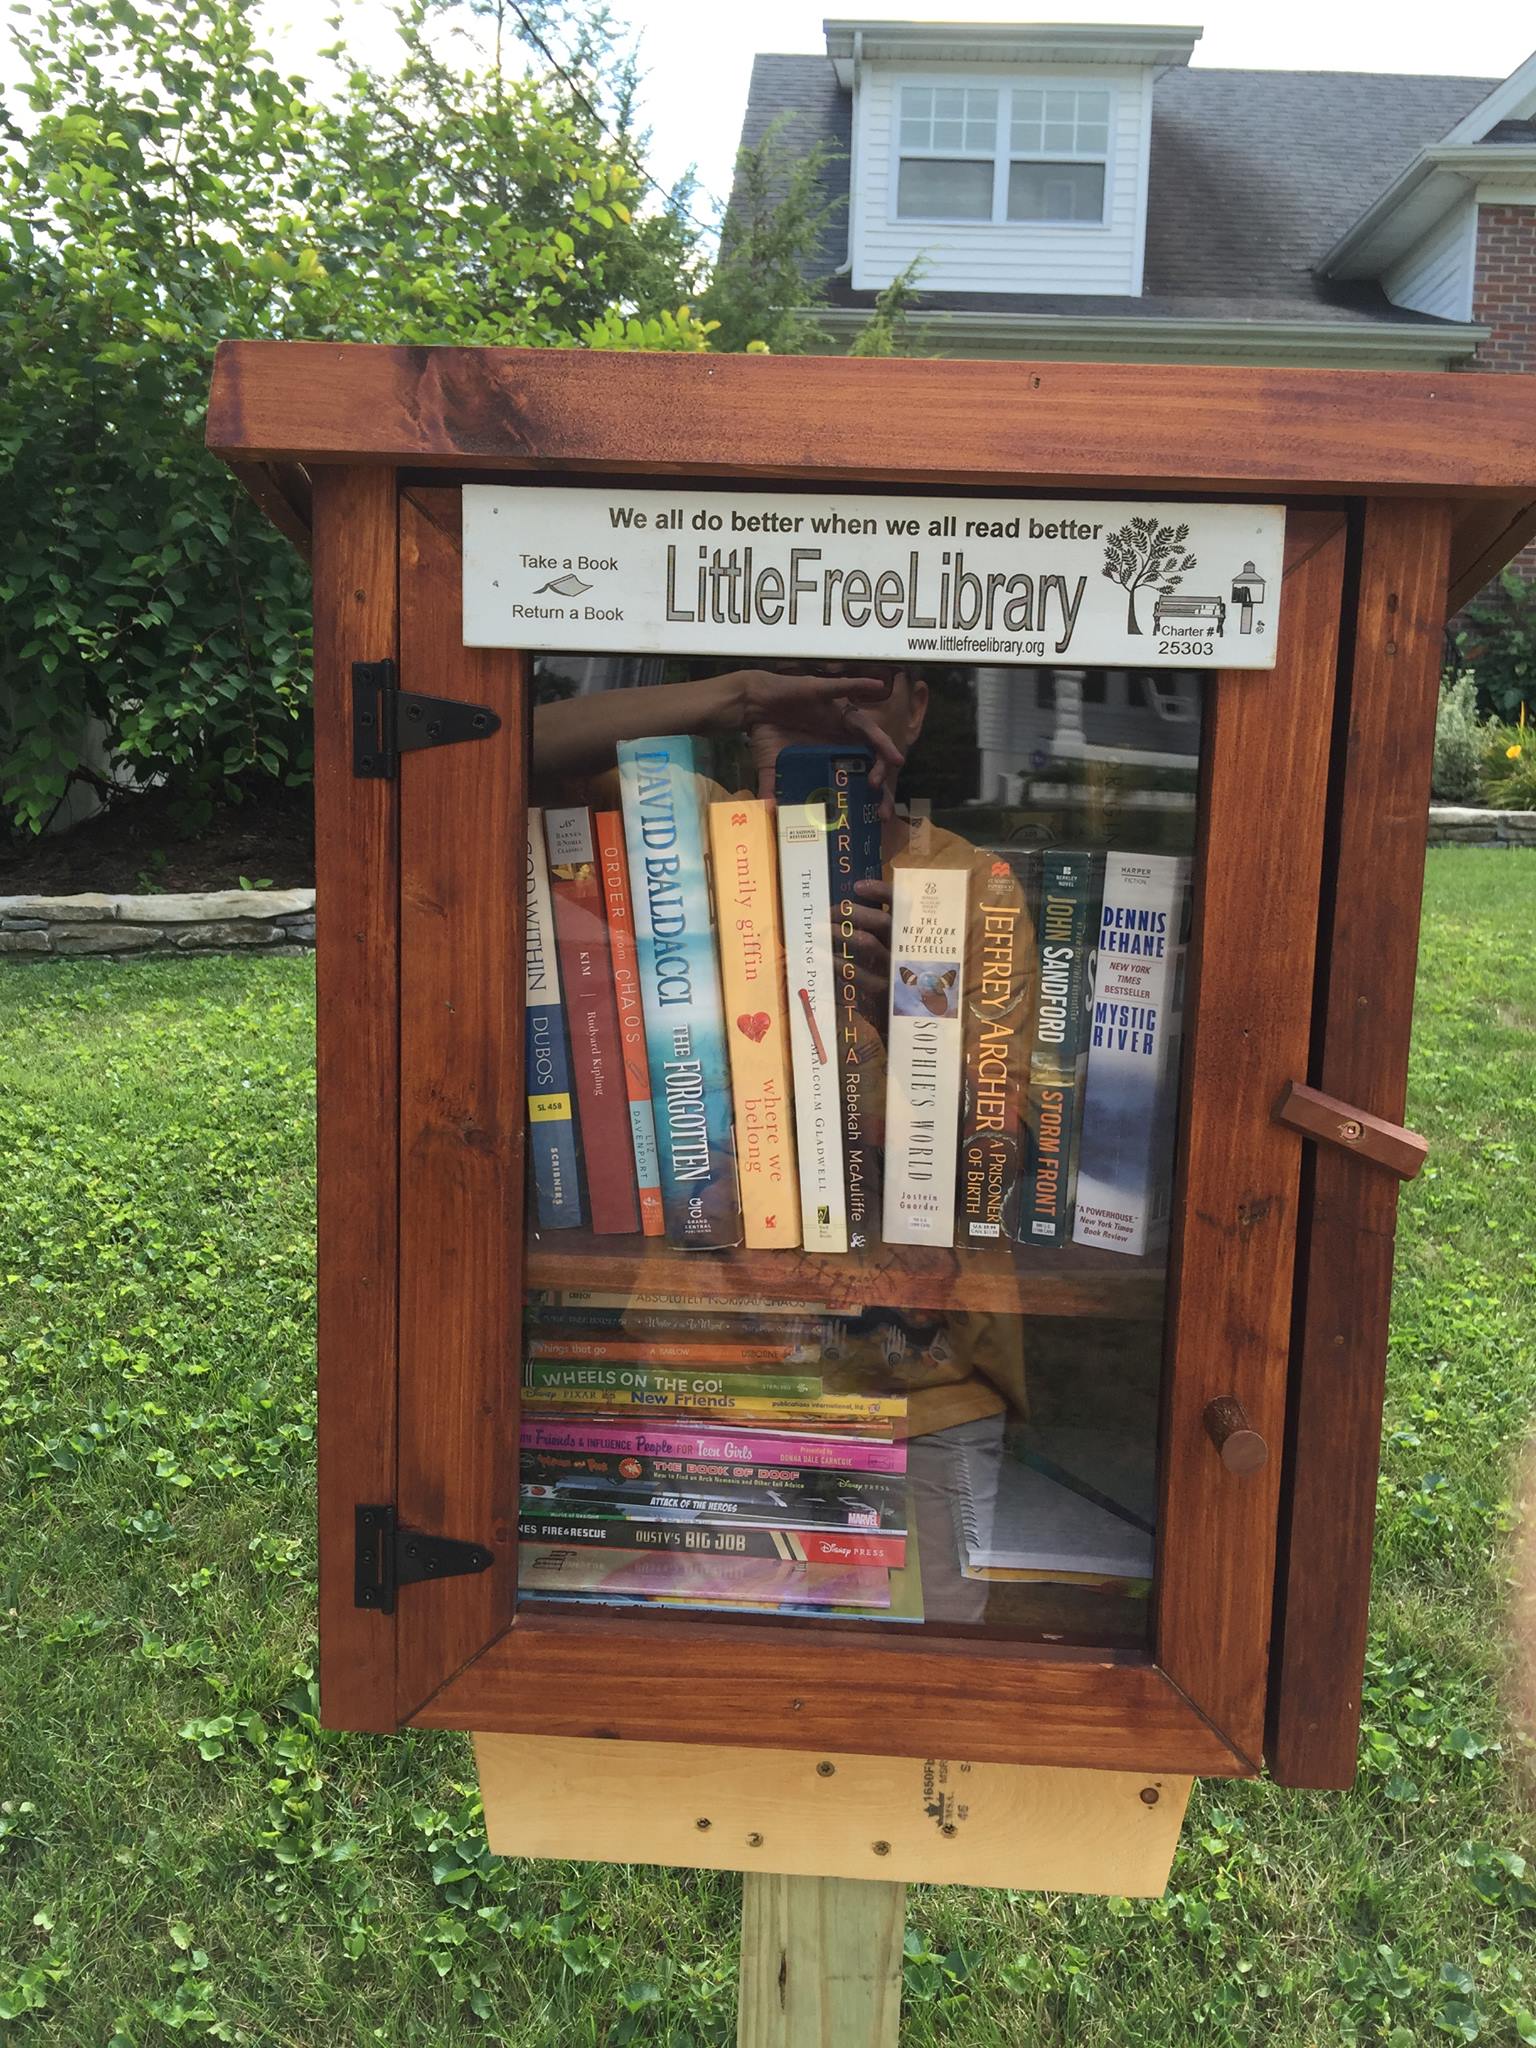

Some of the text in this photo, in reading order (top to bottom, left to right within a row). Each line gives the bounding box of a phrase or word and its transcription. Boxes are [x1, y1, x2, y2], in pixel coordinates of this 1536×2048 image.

[609, 507, 1103, 541] We all do better when we all read better
[519, 554, 619, 571] Take a Book
[666, 544, 1087, 653] LittleFreeLibrary
[512, 604, 624, 621] Return a Book
[1161, 624, 1216, 638] Charter #
[907, 636, 1045, 657] www.littlefreelibrary.org
[1158, 641, 1214, 656] 25303
[835, 769, 851, 873] GEARS
[635, 751, 693, 1008] DAVID BALDACCI
[1121, 866, 1151, 875] HARPER
[1124, 877, 1147, 885] FICTION
[801, 870, 812, 898] THE
[735, 844, 762, 981] emily giffin
[921, 917, 938, 925] THE
[1103, 906, 1166, 933] DENNIS
[803, 905, 814, 965] TIPPING
[903, 926, 957, 936] NEW YORK
[914, 936, 944, 945] TIMES
[604, 847, 640, 1043] ORDER from CHAOS
[898, 945, 957, 954] BESTSELLER
[979, 902, 1021, 1010] JEFFREY
[1100, 930, 1165, 958] LEHANE
[579, 952, 591, 976] KIM
[1038, 895, 1077, 1044] JOHN SANDFORD
[1109, 962, 1151, 975] NEW YORK
[839, 899, 859, 1064] GOLGOTHA
[1117, 974, 1141, 985] TIMES
[1104, 985, 1151, 999] BESTSELLER
[1095, 1002, 1157, 1031] MYSTIC
[532, 1017, 553, 1085] DUBOS
[1093, 1026, 1153, 1055] RIVER
[587, 1011, 604, 1096] Rudyard Kipling
[976, 1019, 1015, 1131] ARCHER
[537, 1102, 562, 1112] SL 458
[663, 1023, 711, 1181] THE FORGOTTEN
[908, 1021, 938, 1181] SOPHIE'S WORLD
[763, 1078, 782, 1182] where we
[1038, 1090, 1064, 1153] STORM
[633, 1110, 647, 1179] DAVENPORT
[645, 1134, 655, 1153] LIZ
[744, 1099, 764, 1173] belong
[846, 1073, 866, 1222] Rebekah McAuliffe
[815, 1118, 827, 1192] GLADWELL
[968, 1148, 983, 1167] OF
[551, 1147, 563, 1205] SCRIBNERS
[987, 1139, 1006, 1222] A PRISONER
[1035, 1157, 1059, 1216] FRONT
[901, 1192, 938, 1201] Jostein
[967, 1171, 984, 1214] BIRTH
[1080, 1216, 1134, 1233] New York Times
[1083, 1226, 1129, 1243] Book Review
[572, 1345, 591, 1354] that
[594, 1346, 606, 1355] go
[542, 1371, 723, 1393] WHEELS ON THE GO!
[563, 1391, 596, 1399] PIXAR
[631, 1391, 668, 1404] New
[674, 1394, 735, 1408] Friends
[535, 1429, 576, 1447] Friends
[587, 1438, 631, 1450] INFLUENCE
[635, 1435, 673, 1454] People
[677, 1444, 693, 1454] FOR
[697, 1440, 720, 1457] Teen
[723, 1442, 753, 1460] Girls
[653, 1461, 801, 1480] THE BOOK OF DOOF
[780, 1454, 854, 1466] DONNA DALE CARNEGIE
[837, 1478, 863, 1491] Disney
[650, 1496, 738, 1512] ATTACK OF THE HEROES
[848, 1512, 879, 1526] MARVEL
[636, 1530, 746, 1551] DUSTY'S BIG JOB
[819, 1541, 884, 1557] Disney PRESS
